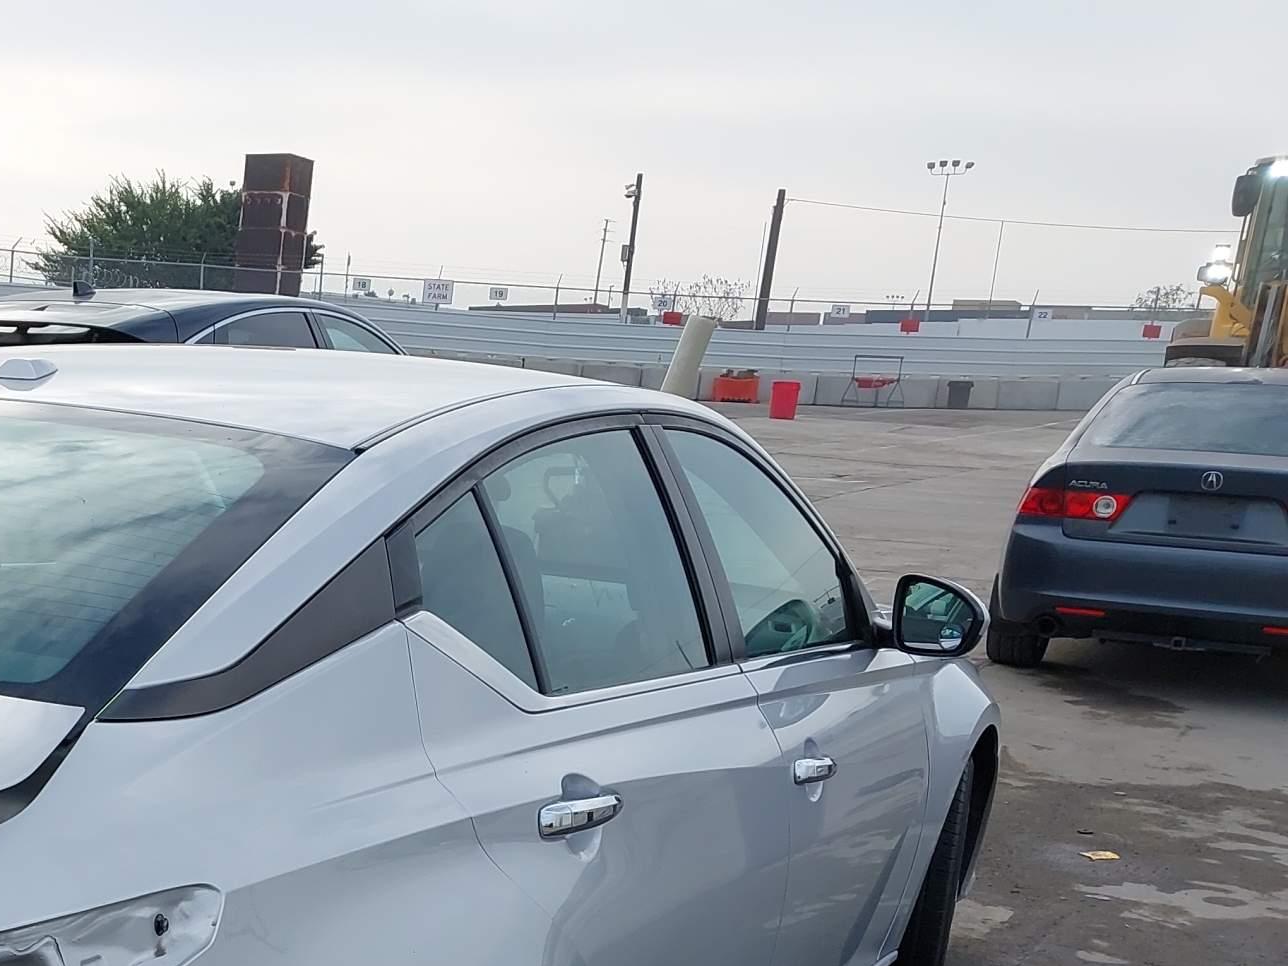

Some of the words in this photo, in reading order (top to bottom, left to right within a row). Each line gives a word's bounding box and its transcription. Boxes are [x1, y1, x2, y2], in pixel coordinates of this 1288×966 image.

[427, 283, 450, 291] STATE
[426, 292, 449, 300] FARM
[494, 290, 504, 298] 19
[657, 299, 668, 307] 20
[835, 307, 846, 315] 21
[1038, 311, 1048, 319] 22
[1068, 479, 1109, 490] ACURA
